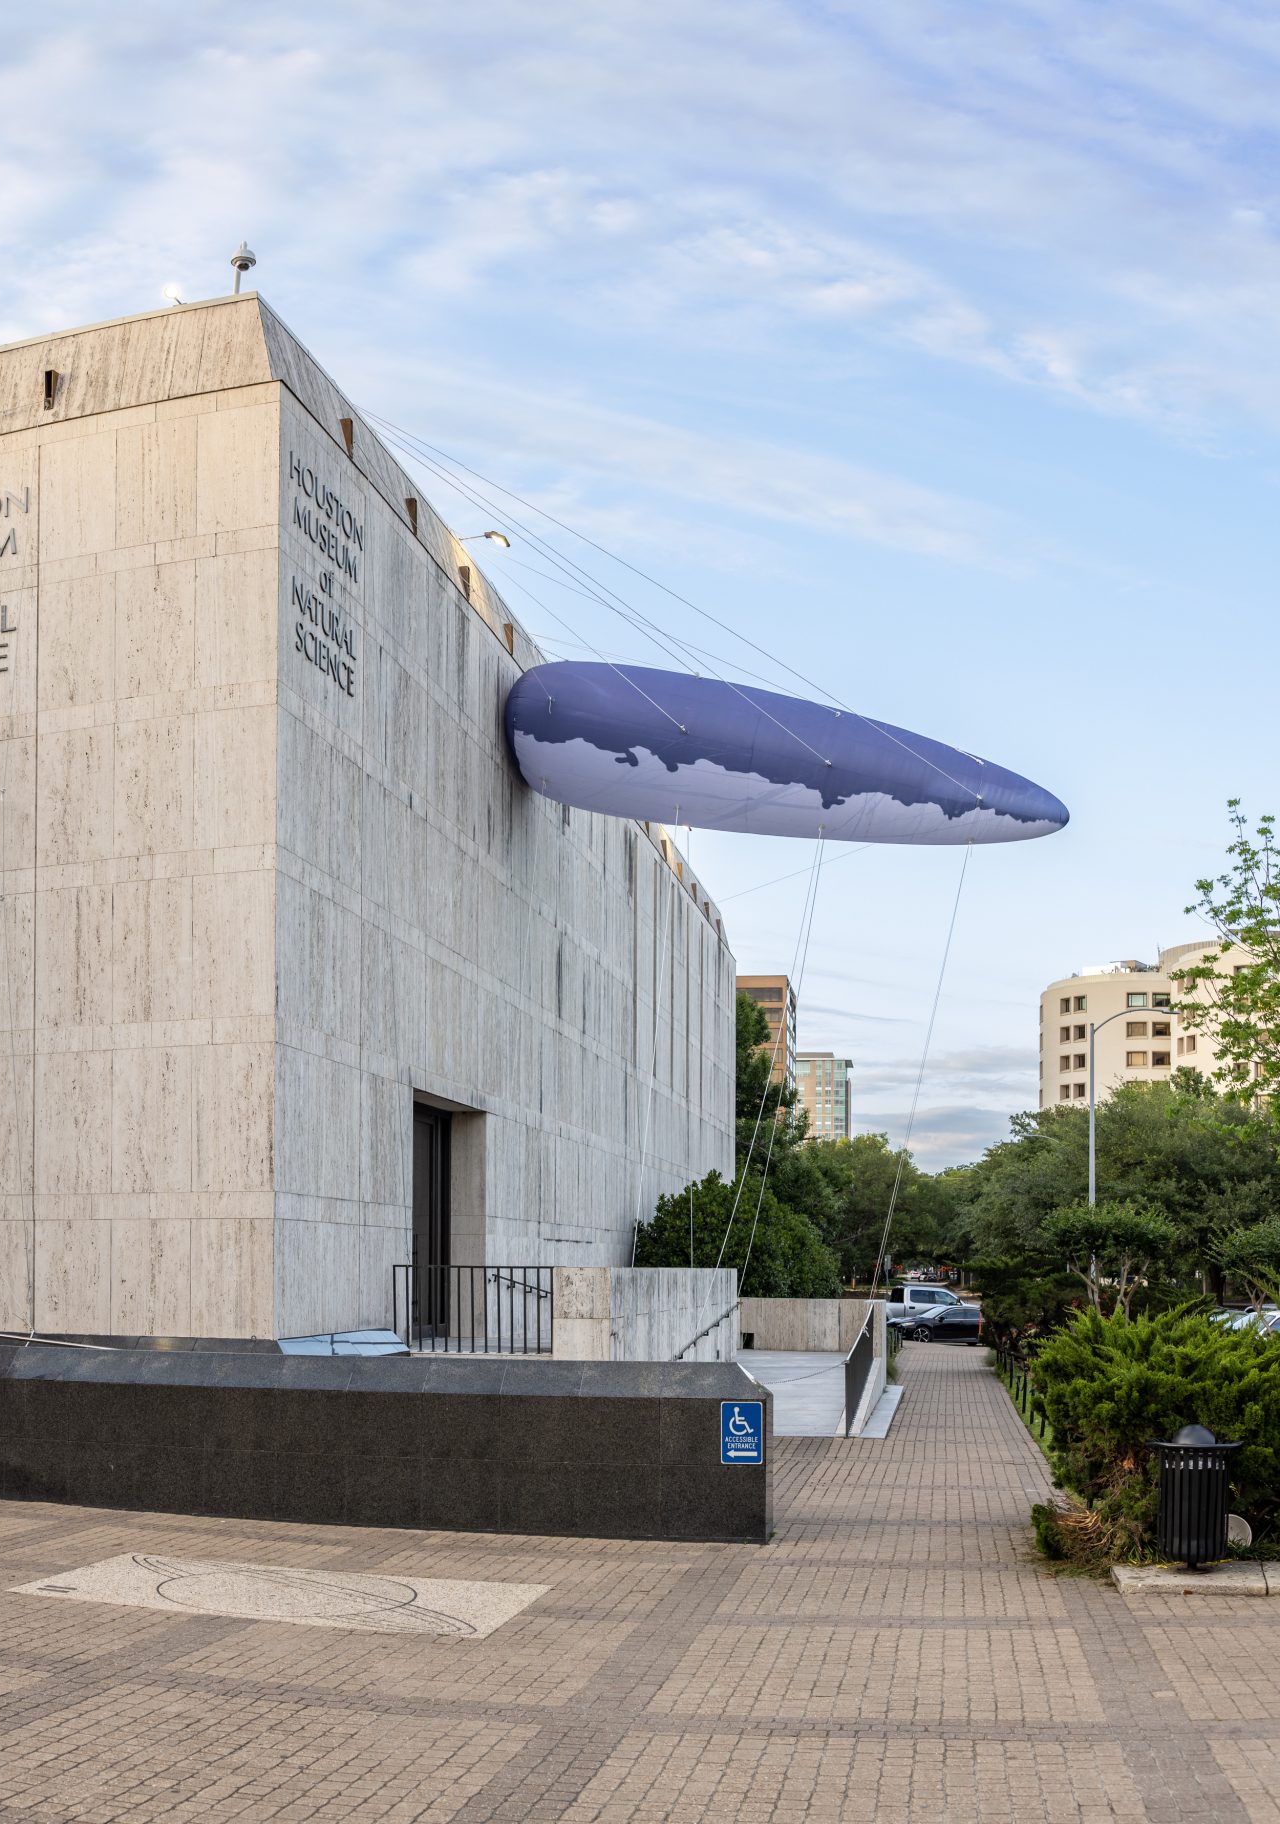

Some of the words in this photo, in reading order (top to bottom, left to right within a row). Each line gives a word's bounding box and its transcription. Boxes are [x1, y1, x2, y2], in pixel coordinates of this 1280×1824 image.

[290, 450, 363, 551] HOUSTON
[293, 496, 358, 583] MUSEUM
[292, 575, 356, 661] NATURAL
[319, 569, 335, 598] of
[295, 620, 354, 698] SCIENCE
